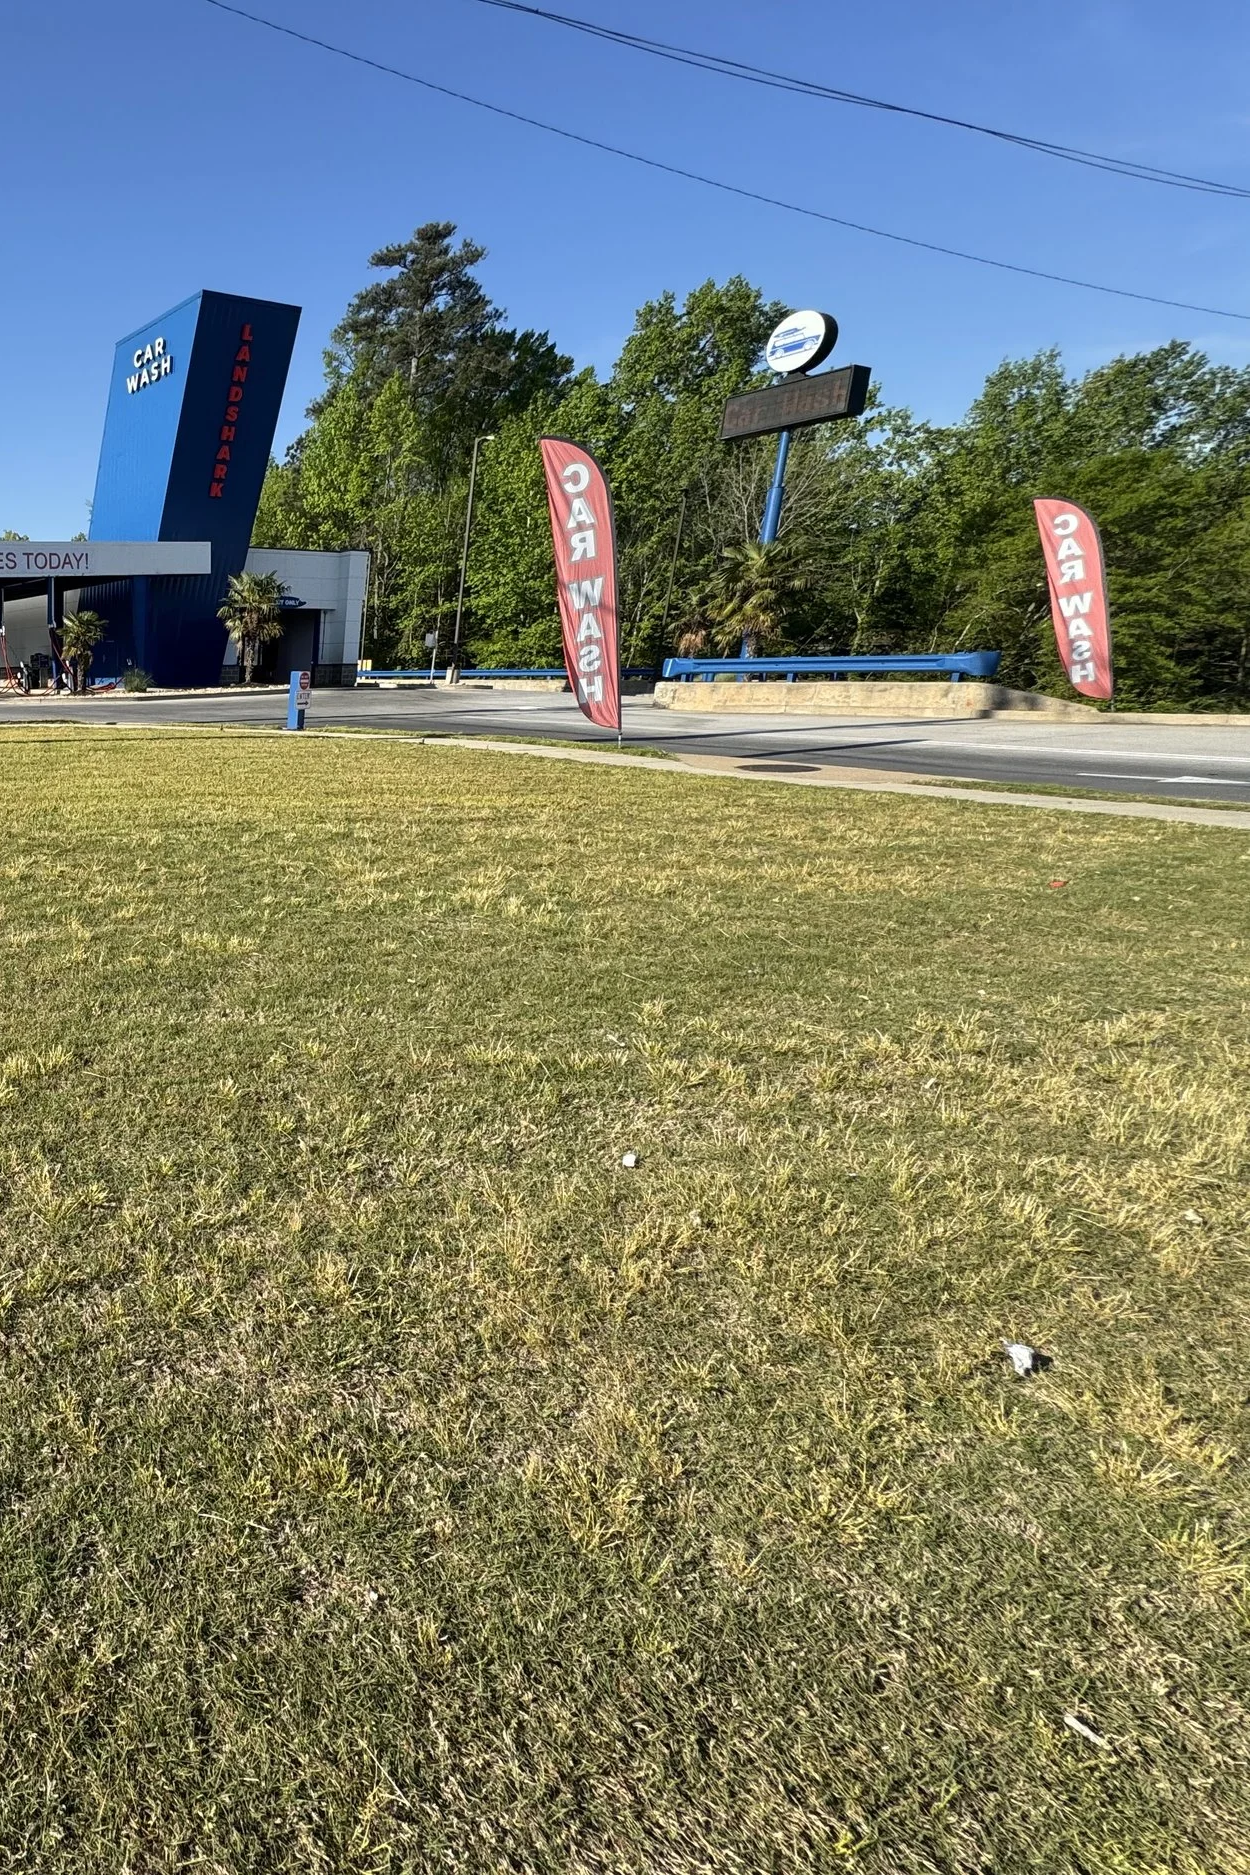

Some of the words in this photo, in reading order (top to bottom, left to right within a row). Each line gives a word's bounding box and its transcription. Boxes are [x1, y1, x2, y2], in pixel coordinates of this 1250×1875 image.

[133, 336, 165, 368] CAR
[126, 355, 171, 394] WASH
[210, 324, 253, 497] LANDSHARK
[22, 552, 90, 570] TODAY!
